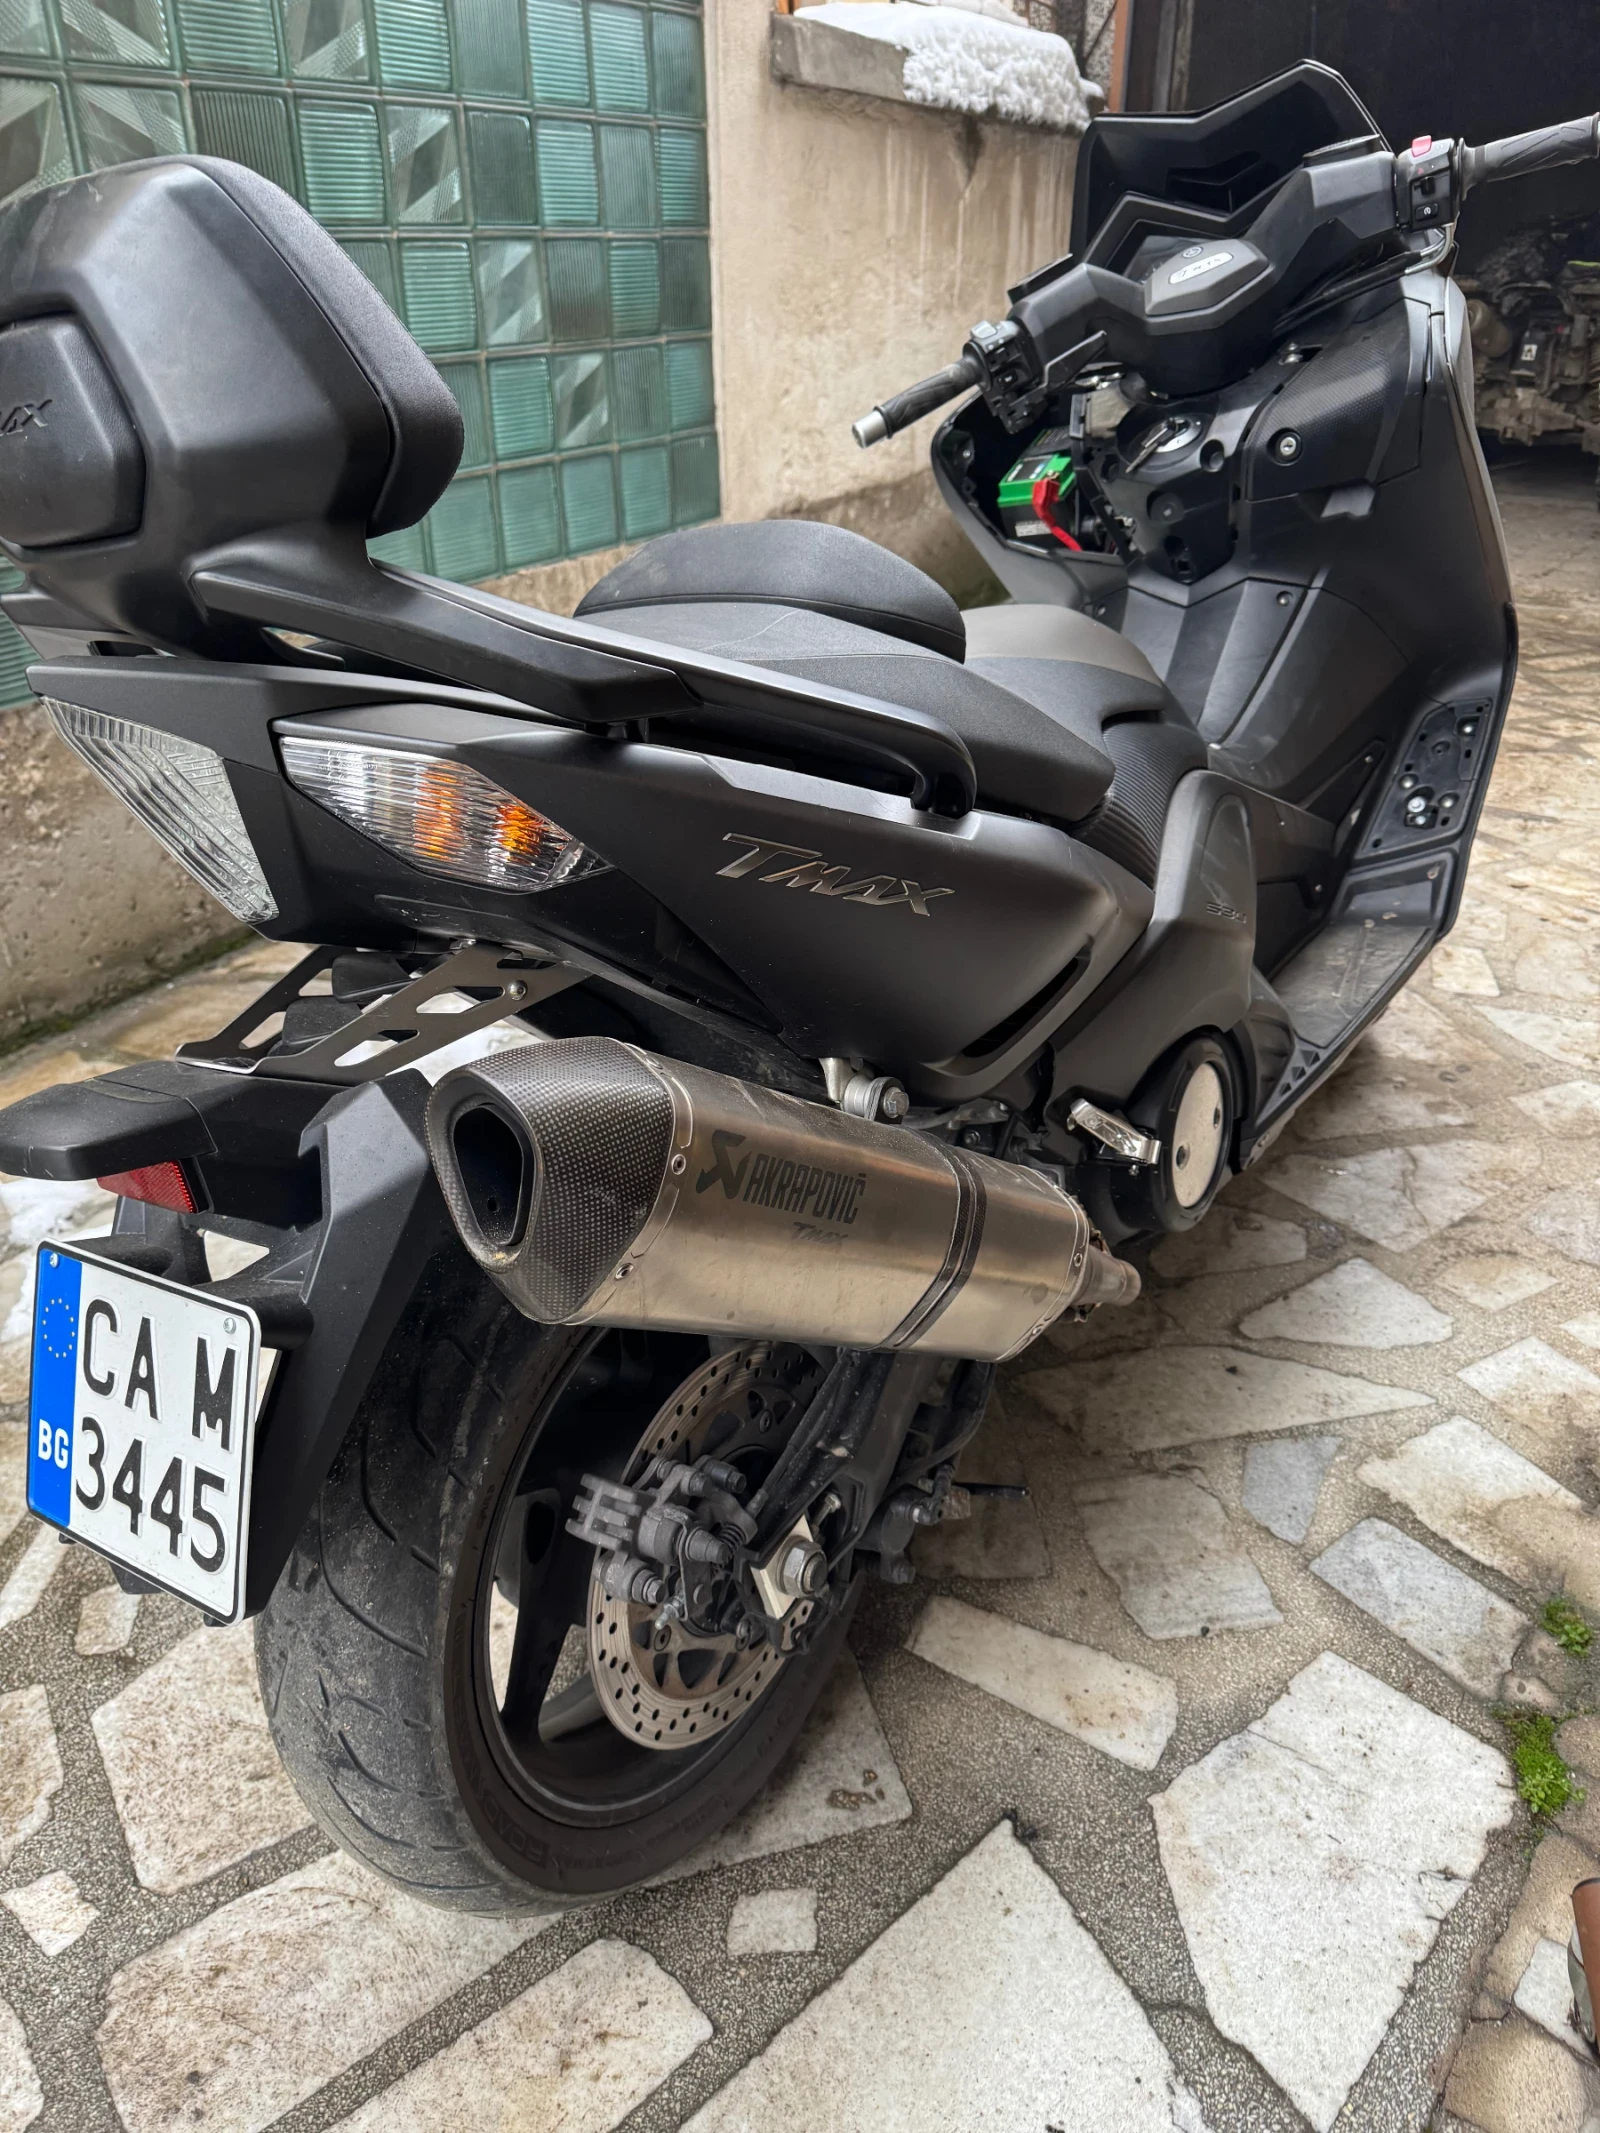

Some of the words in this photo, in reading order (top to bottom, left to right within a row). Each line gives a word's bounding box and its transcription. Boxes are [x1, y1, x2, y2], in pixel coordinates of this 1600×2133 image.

[716, 832, 955, 917] TMAX
[83, 1298, 159, 1421] CA
[191, 1336, 237, 1452] M
[37, 1417, 69, 1470] BG
[75, 1416, 227, 1573] 3445
